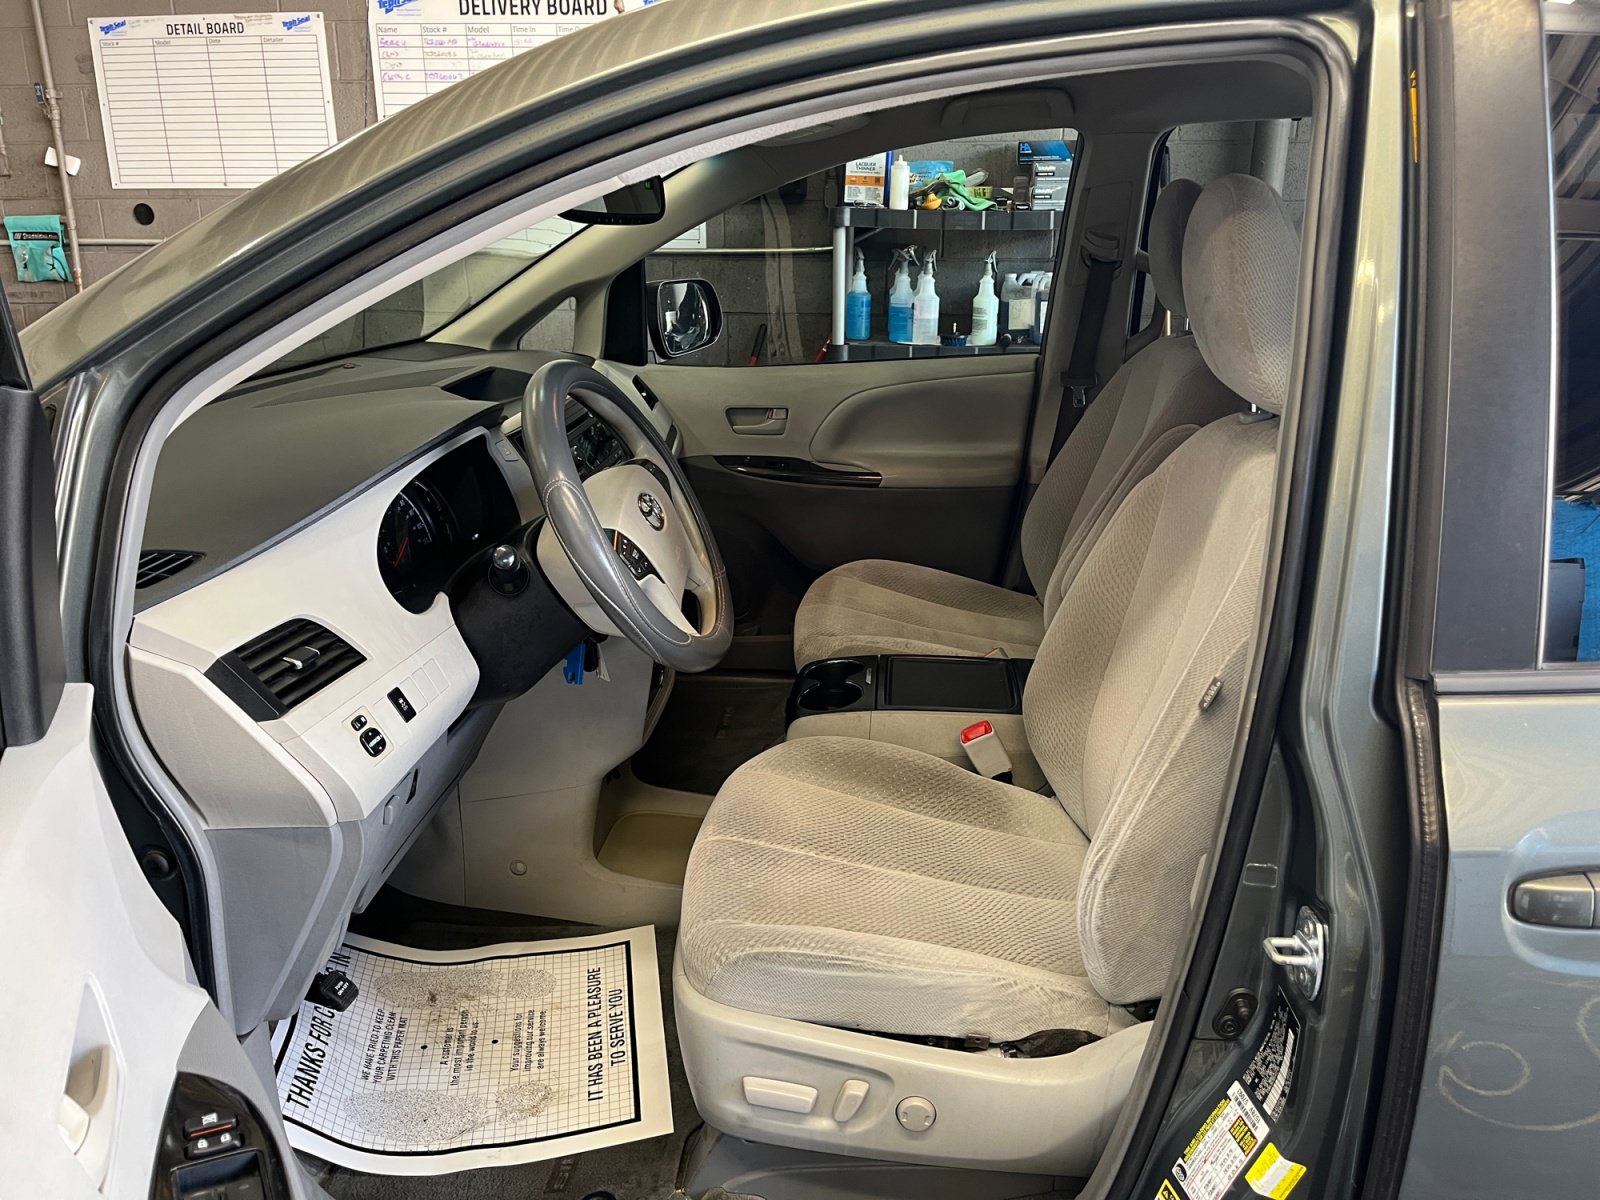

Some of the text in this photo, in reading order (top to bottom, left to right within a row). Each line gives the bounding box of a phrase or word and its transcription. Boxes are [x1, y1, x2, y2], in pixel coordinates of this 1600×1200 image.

[459, 0, 607, 16] DELIVERY BOARD
[166, 22, 204, 35] DETAIL
[206, 22, 244, 34] BOARD
[523, 1009, 535, 1072] improving our service
[587, 967, 603, 1101] IT HAS BEEN A PLEASURE
[609, 988, 625, 1066] TO SERVE YOU
[361, 1008, 385, 1080] WE HAVE TRIED TO KEEP
[373, 1012, 396, 1083] YOUR CARPETING CLEAN
[387, 1016, 408, 1081] WITH THIS PAPER MAT
[442, 1034, 453, 1060] customer
[456, 1030, 466, 1057] important
[469, 1036, 477, 1052] world
[510, 1012, 523, 1072] Your suggestions for
[536, 1037, 546, 1057] always
[286, 1042, 326, 1109] THANKS
[309, 1016, 335, 1046] FOR
[453, 1057, 462, 1074] most
[467, 1053, 475, 1064] the
[450, 1075, 459, 1086] the
